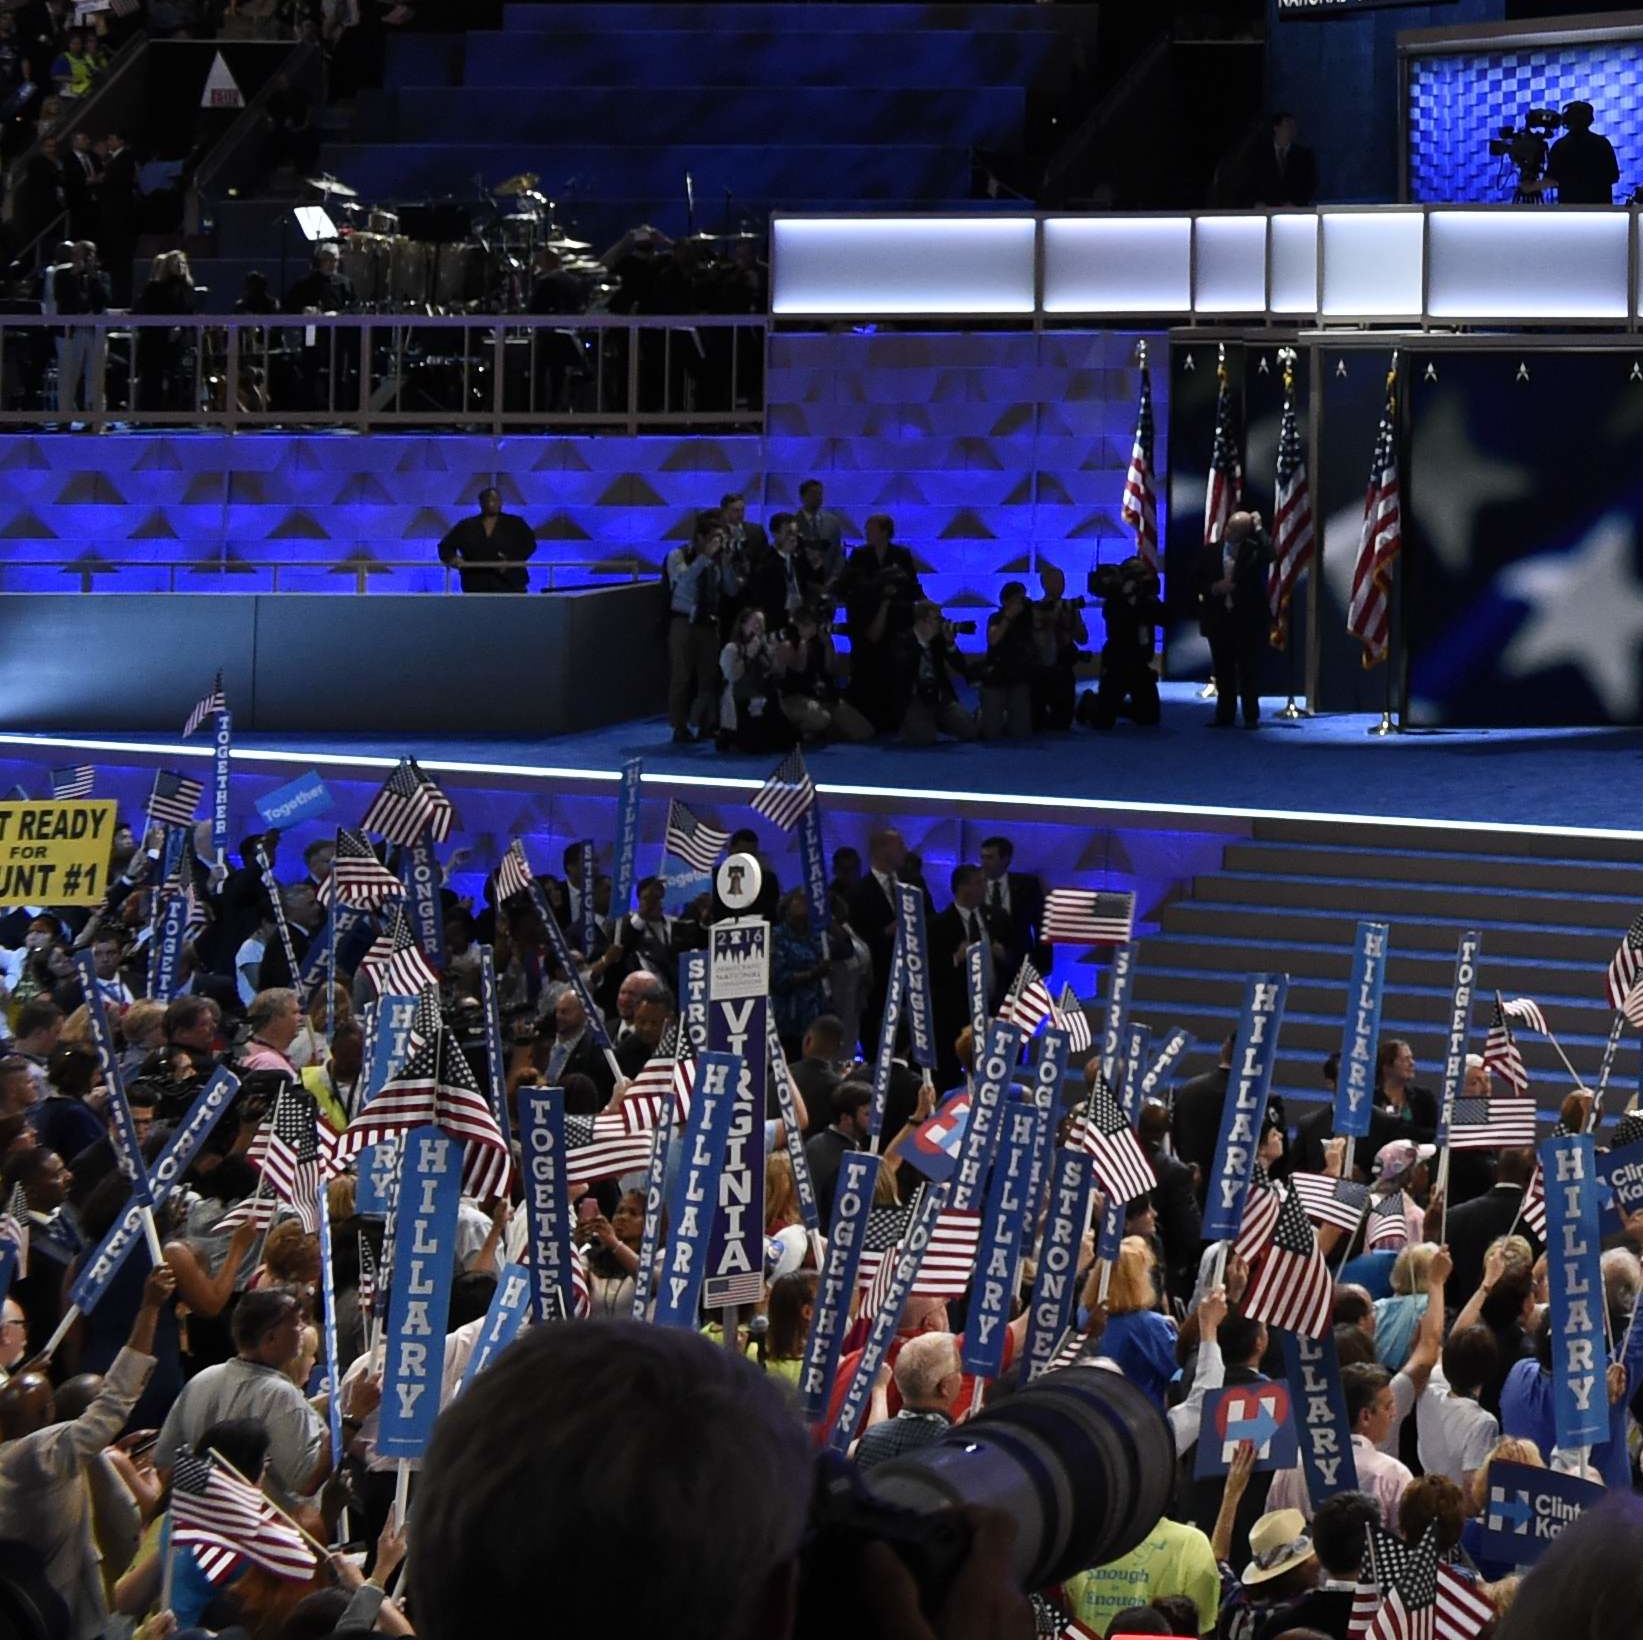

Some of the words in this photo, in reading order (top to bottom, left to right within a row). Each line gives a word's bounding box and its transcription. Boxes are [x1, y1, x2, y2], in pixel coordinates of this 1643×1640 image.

[10, 846, 47, 860] FOR
[34, 808, 108, 840] READY
[215, 715, 229, 835] TOGETHER
[262, 783, 325, 823] Together
[619, 767, 639, 901] HILLARY
[64, 864, 98, 897] #1
[902, 895, 928, 1050] STRONGER
[1347, 933, 1383, 1112] HILLARY
[1441, 942, 1476, 1124] TOGETHER
[1220, 984, 1278, 1208] HILLARY
[668, 1063, 727, 1309] HILLARY
[978, 1117, 1036, 1344] HILLARY
[397, 1139, 448, 1418] HILLARY
[804, 1164, 868, 1395] TOGETHER
[1555, 1149, 1594, 1410] HILLARY
